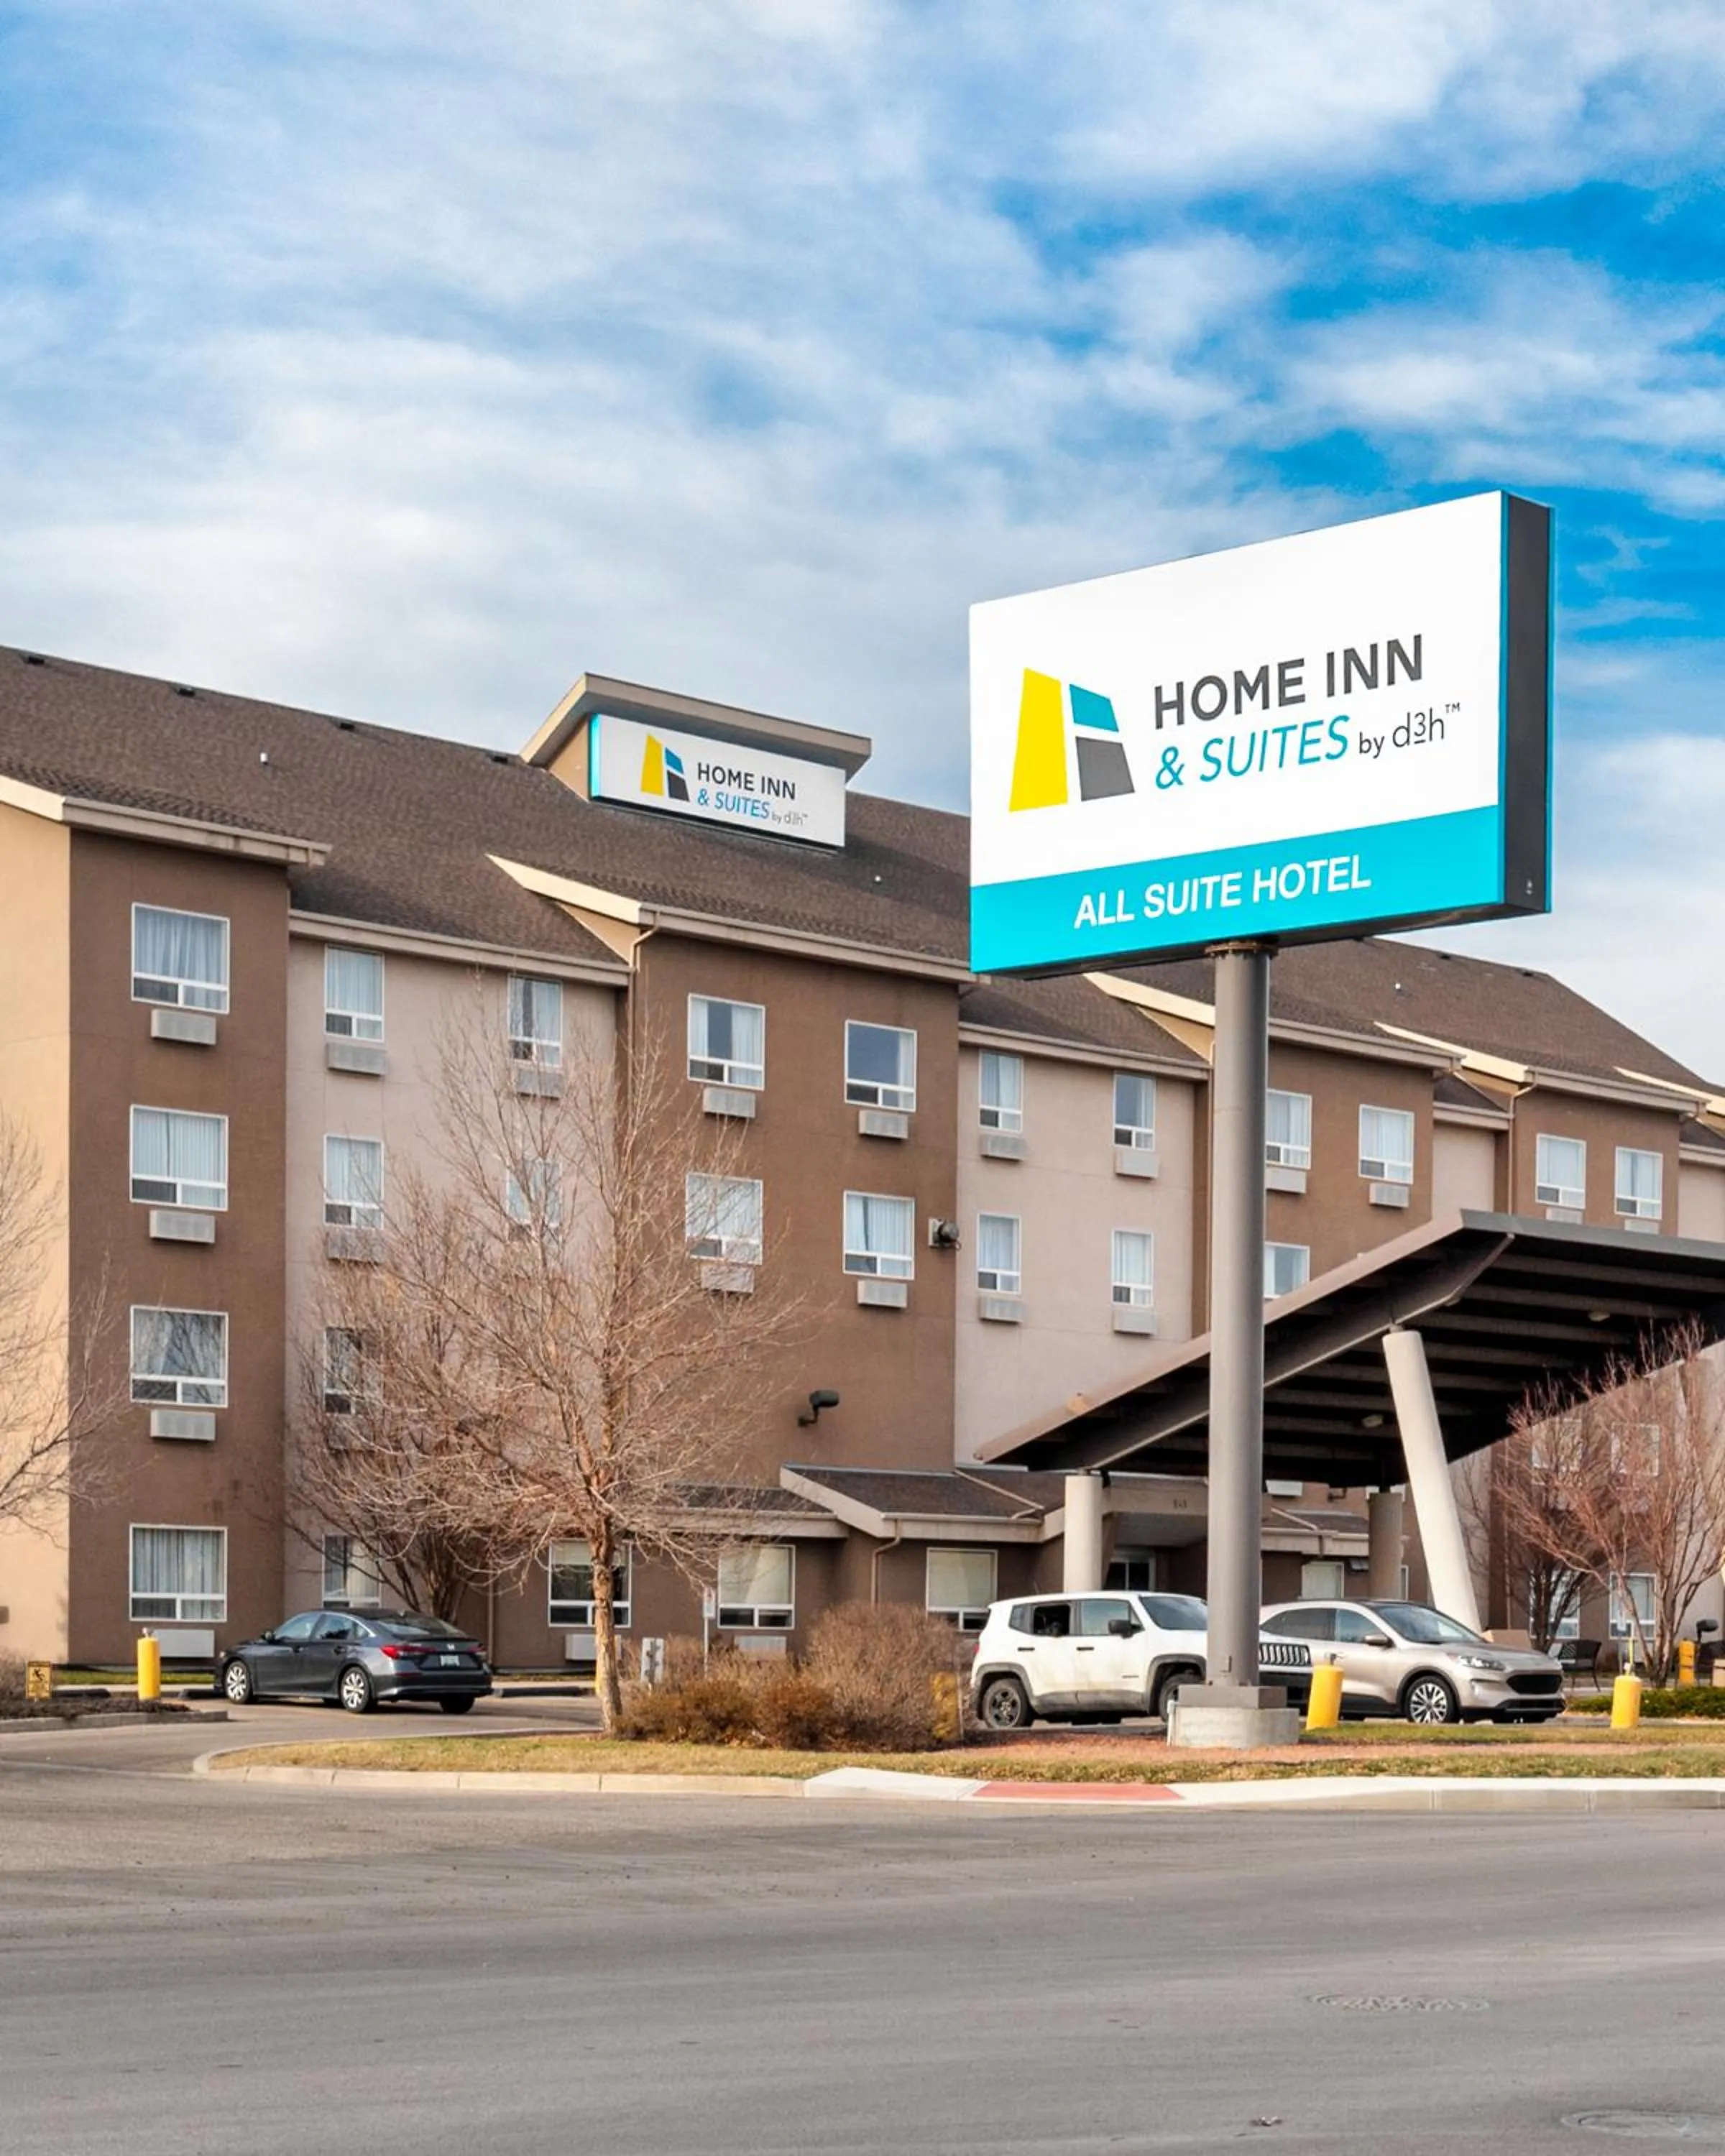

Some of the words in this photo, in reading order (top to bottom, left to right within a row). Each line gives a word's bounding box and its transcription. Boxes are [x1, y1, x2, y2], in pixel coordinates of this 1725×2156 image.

[1154, 657, 1306, 731] HOME
[1326, 633, 1422, 699] INN
[696, 761, 755, 793] HOME
[760, 775, 796, 801] INN
[1154, 745, 1185, 791] &
[1199, 714, 1351, 783] SUITES
[1358, 731, 1385, 760] by
[696, 788, 711, 807] &
[714, 791, 770, 820] SUITES
[1075, 890, 1134, 929] ALL
[1144, 872, 1242, 918] SUITE
[1253, 855, 1371, 902] HOTEL
